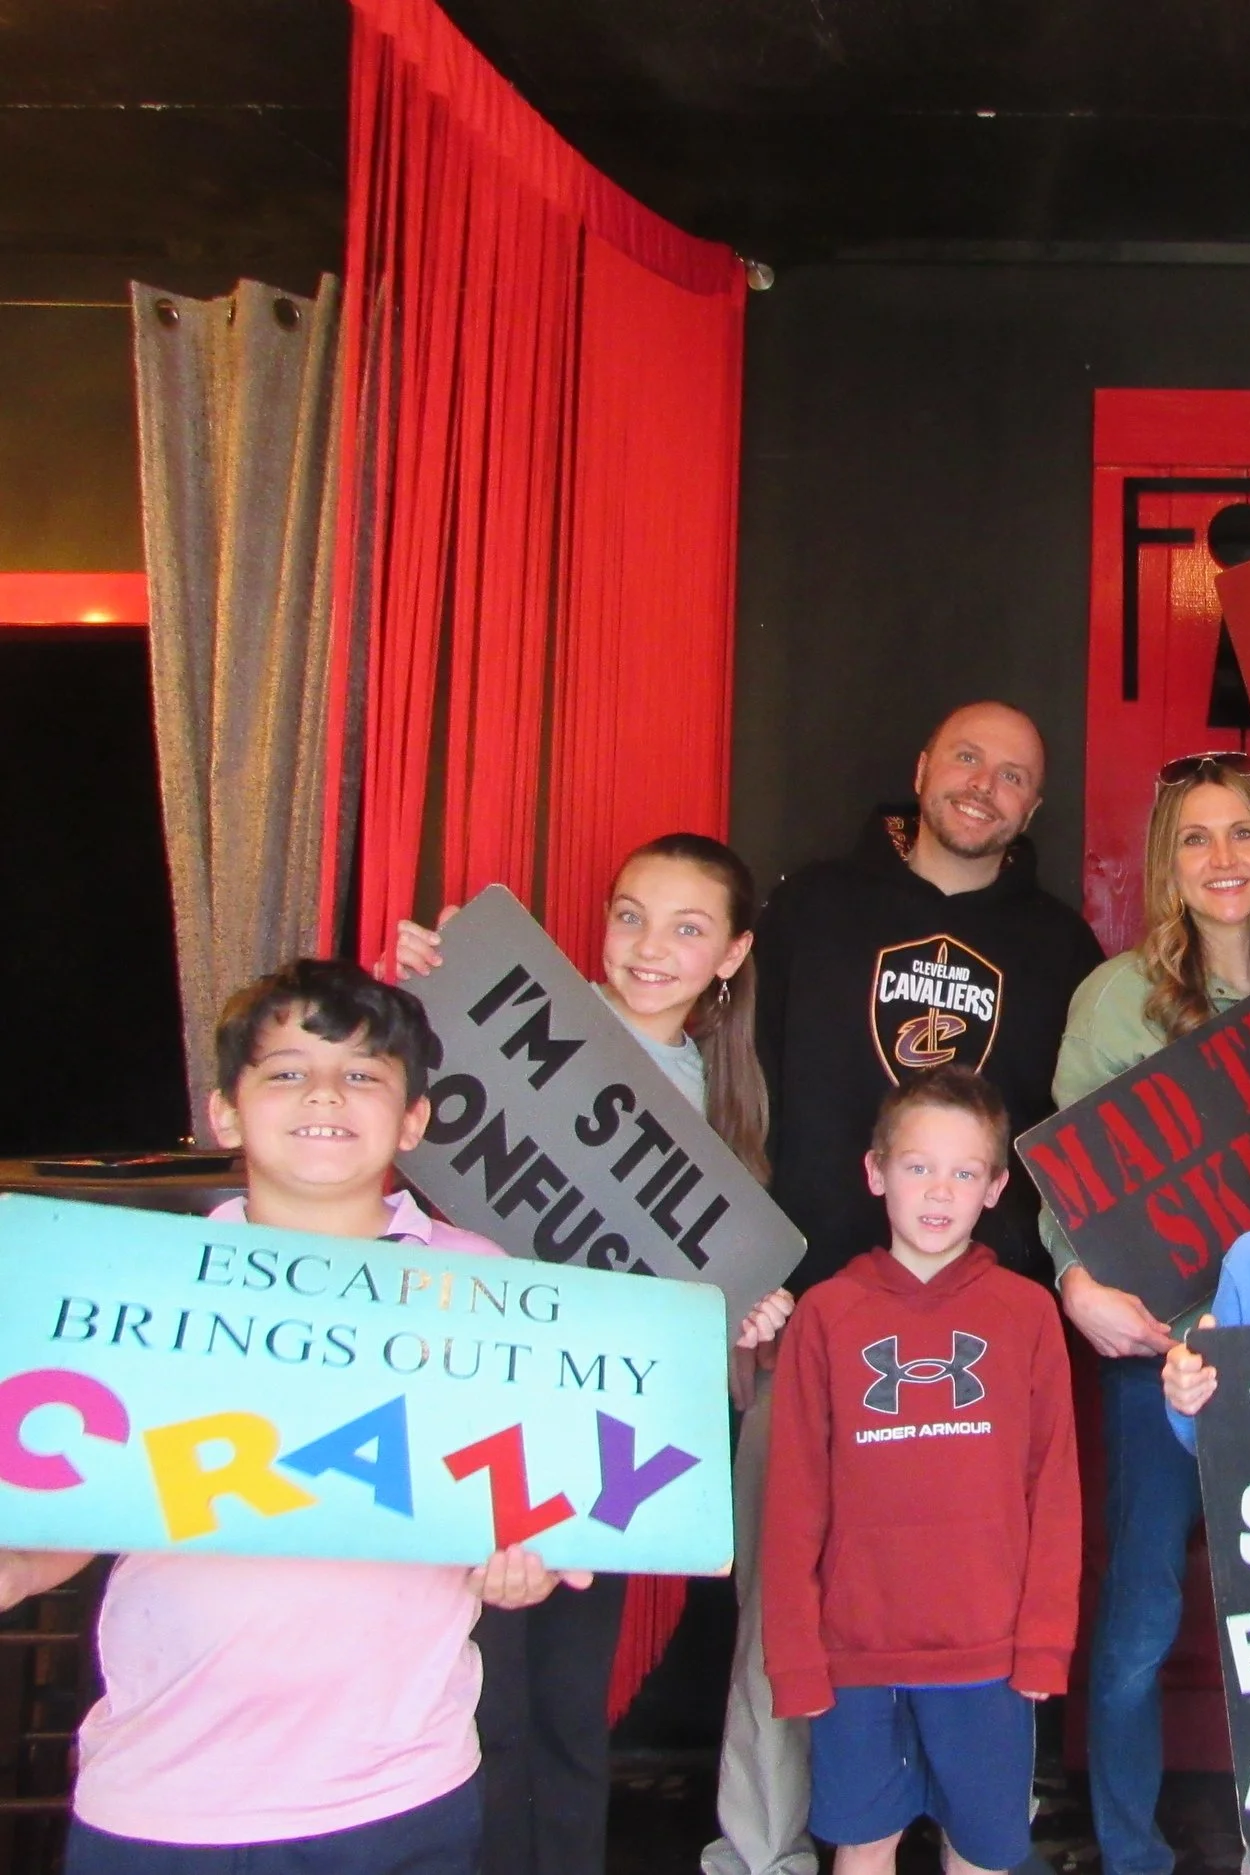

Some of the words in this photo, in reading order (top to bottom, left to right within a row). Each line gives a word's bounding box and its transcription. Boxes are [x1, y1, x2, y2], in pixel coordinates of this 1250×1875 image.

[879, 970, 995, 1022] CAVALIERS
[912, 959, 970, 982] CLEVELAND
[423, 1031, 657, 1277] ONFUS
[467, 963, 587, 1091] I'M
[574, 1082, 731, 1271] STILL
[1030, 1072, 1204, 1231] MAD
[197, 1243, 560, 1324] ESCAPING
[52, 1297, 358, 1368] BRINGS
[383, 1332, 532, 1383] OUT
[559, 1348, 659, 1396] MY
[0, 1367, 701, 1551] CRAZY
[856, 1425, 916, 1444] UNDER
[919, 1421, 991, 1438] ARMOUR
